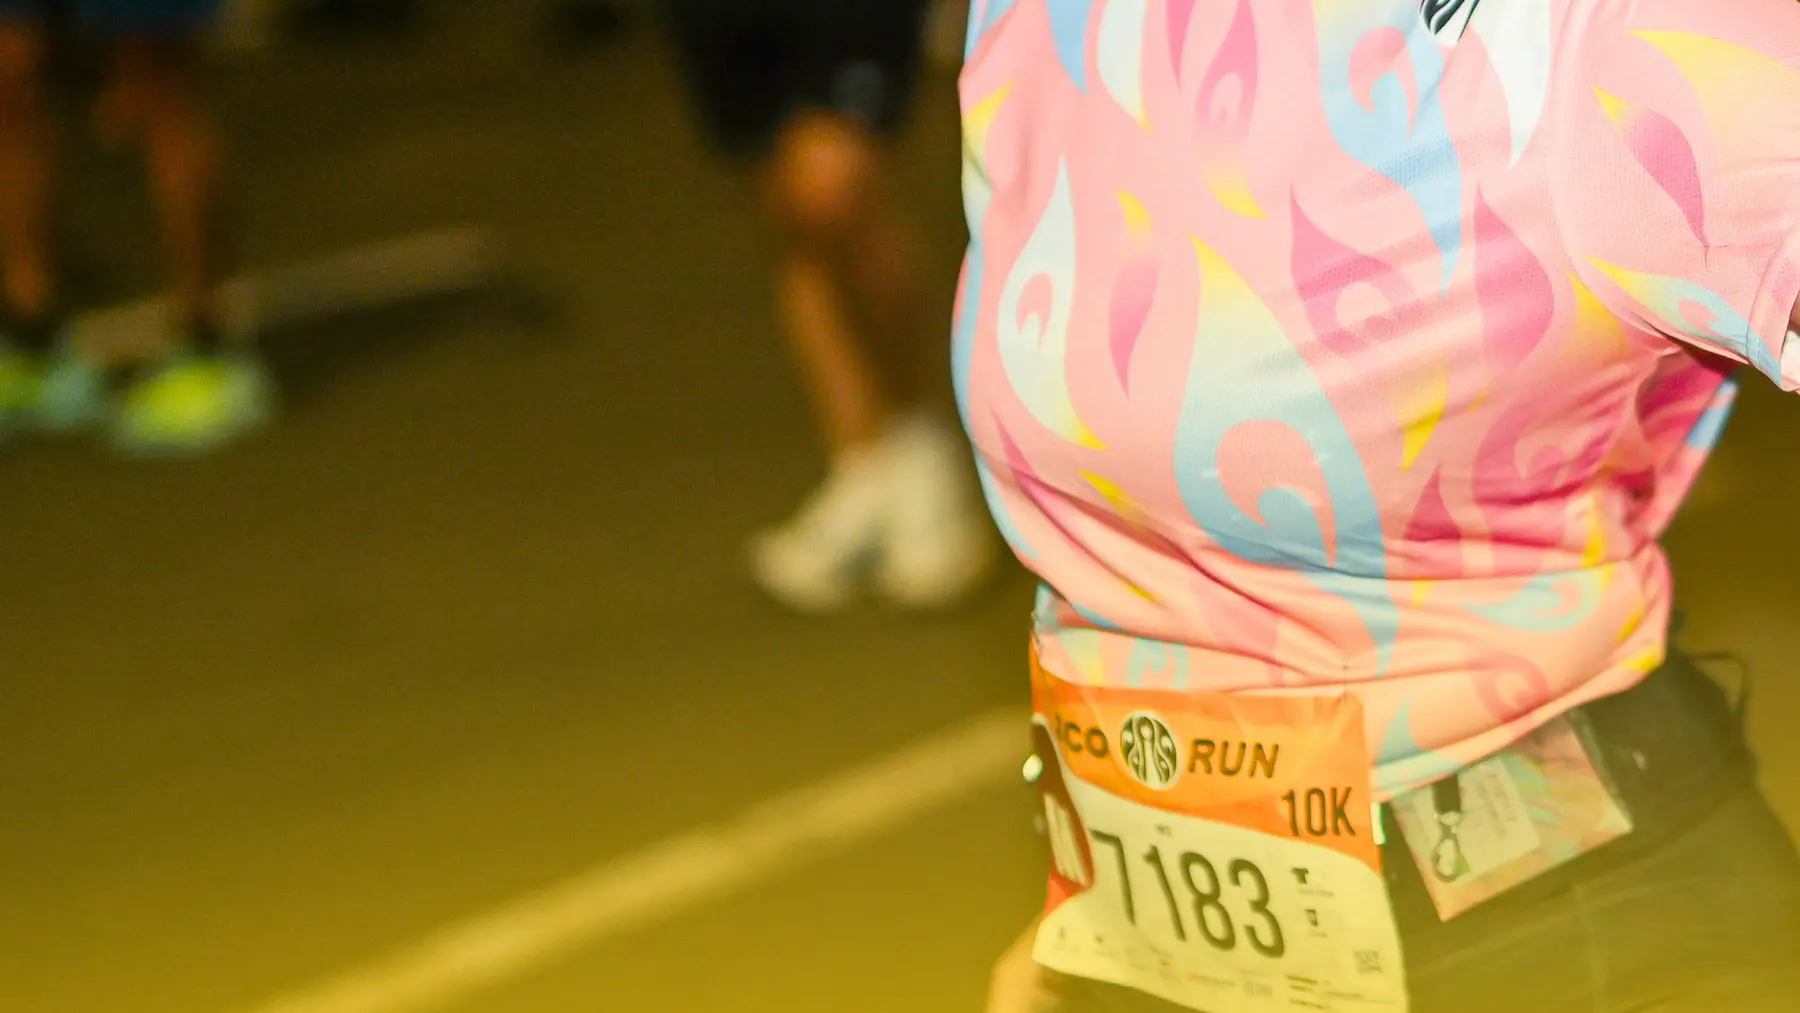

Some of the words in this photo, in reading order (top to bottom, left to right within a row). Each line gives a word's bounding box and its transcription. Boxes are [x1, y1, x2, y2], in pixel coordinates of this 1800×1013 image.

[1187, 738, 1280, 779] RUN
[1281, 786, 1357, 837] 10K
[1088, 827, 1285, 959] 7183
